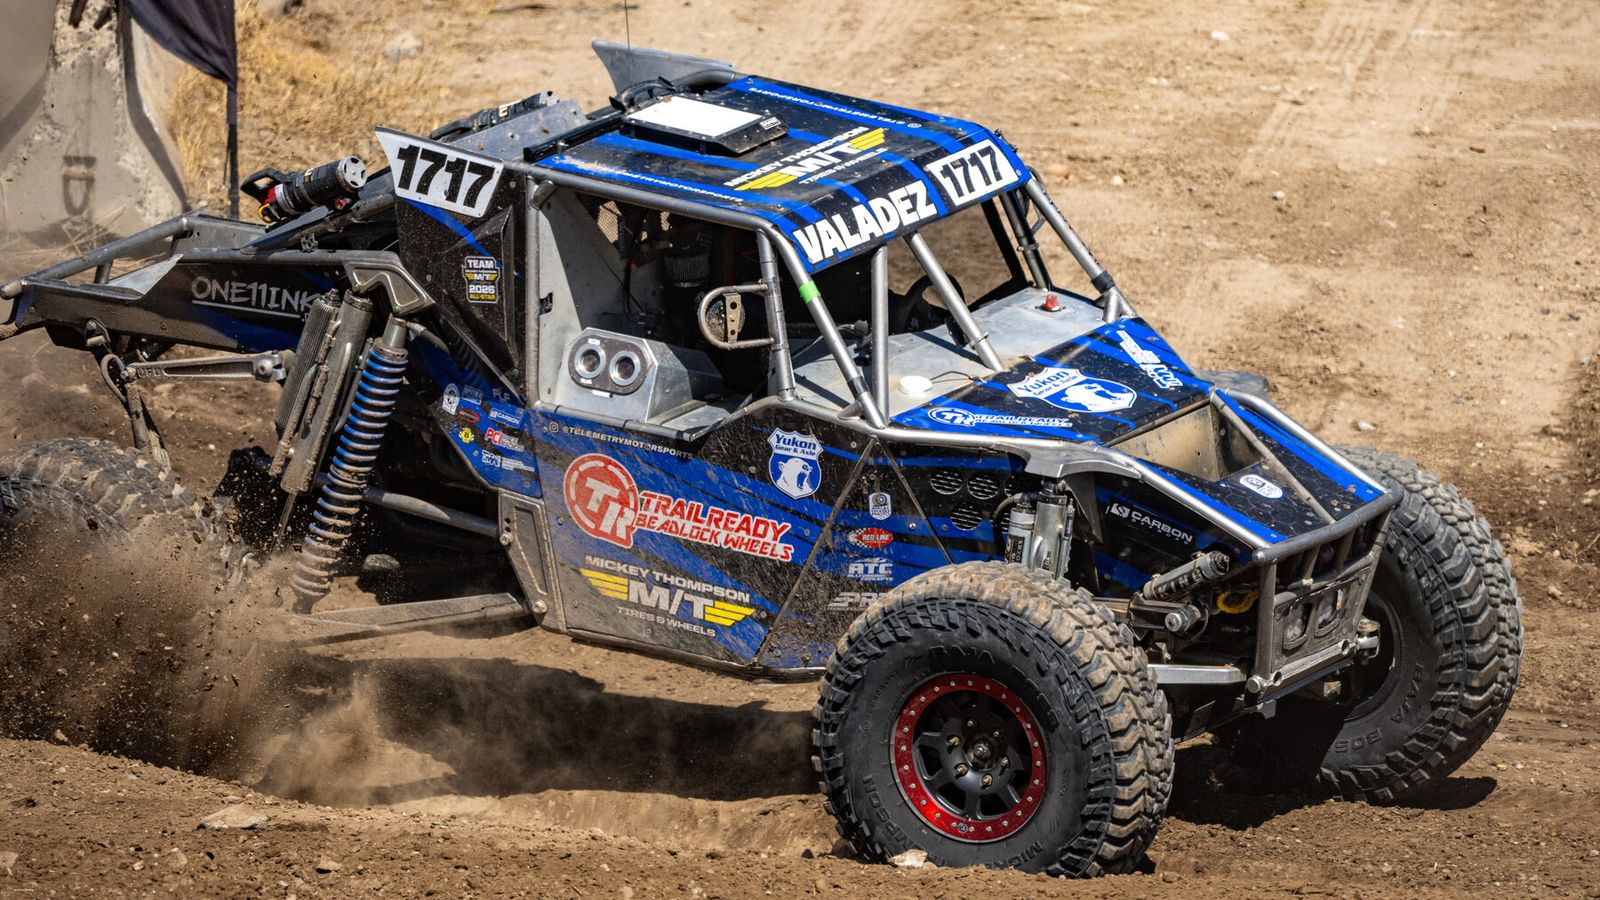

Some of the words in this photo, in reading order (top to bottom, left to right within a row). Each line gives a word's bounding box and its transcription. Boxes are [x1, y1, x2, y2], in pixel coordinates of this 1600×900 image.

[723, 161, 783, 187] MICKEY
[781, 126, 870, 162] THOMPSON
[777, 142, 863, 177] M/T
[940, 145, 1003, 199] 1717
[397, 144, 495, 208] 1717
[792, 180, 938, 264] VALADEZ
[467, 259, 494, 269] TEAM
[469, 284, 495, 294] 2026
[1017, 370, 1070, 393] Yukon
[484, 427, 503, 446] PCI
[775, 433, 817, 450] Yukon
[775, 444, 793, 452] Gear
[585, 477, 636, 540] TR
[639, 491, 790, 543] TRAILREADY
[635, 513, 722, 545] BEADLOCK
[723, 532, 794, 561] WHEELS
[1131, 510, 1193, 543] CARBON
[585, 555, 651, 578] MICKEY
[652, 571, 751, 603] THOMPSON
[848, 562, 893, 574] ATC
[629, 579, 714, 620] M/T
[617, 605, 655, 622] TIRES
[656, 615, 666, 624] &
[667, 618, 716, 638] WHEELS
[1333, 727, 1382, 753] BOS
